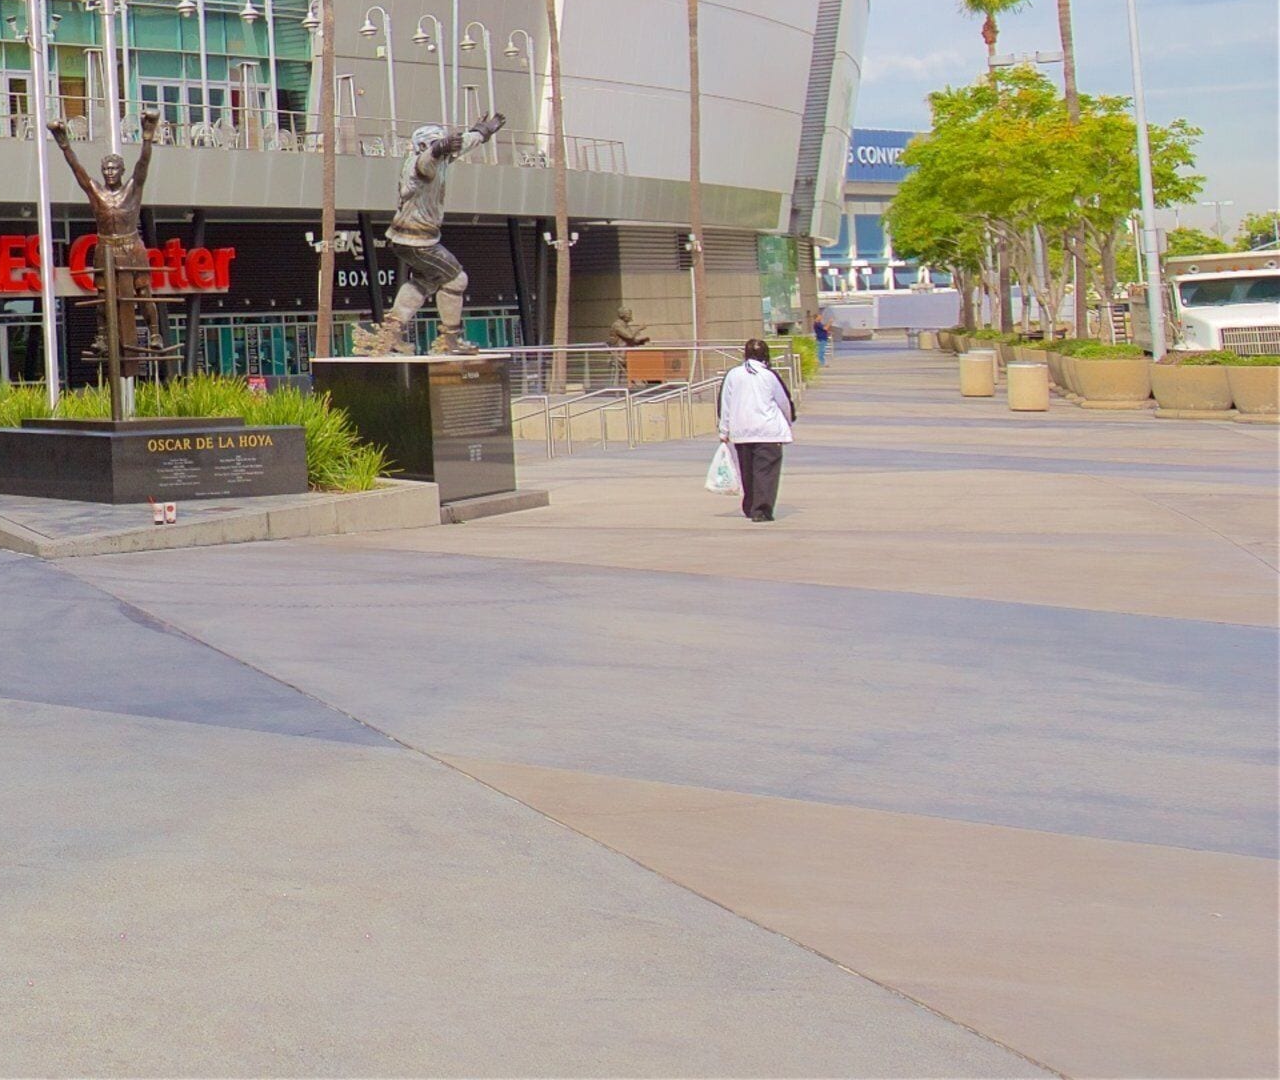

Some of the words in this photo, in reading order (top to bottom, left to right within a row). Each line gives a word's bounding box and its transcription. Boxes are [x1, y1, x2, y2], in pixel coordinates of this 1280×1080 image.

[338, 270, 369, 287] BOX
[147, 438, 192, 452] OSCAR
[196, 437, 214, 450] DE
[219, 436, 235, 449] LA
[239, 434, 274, 448] HOYA
